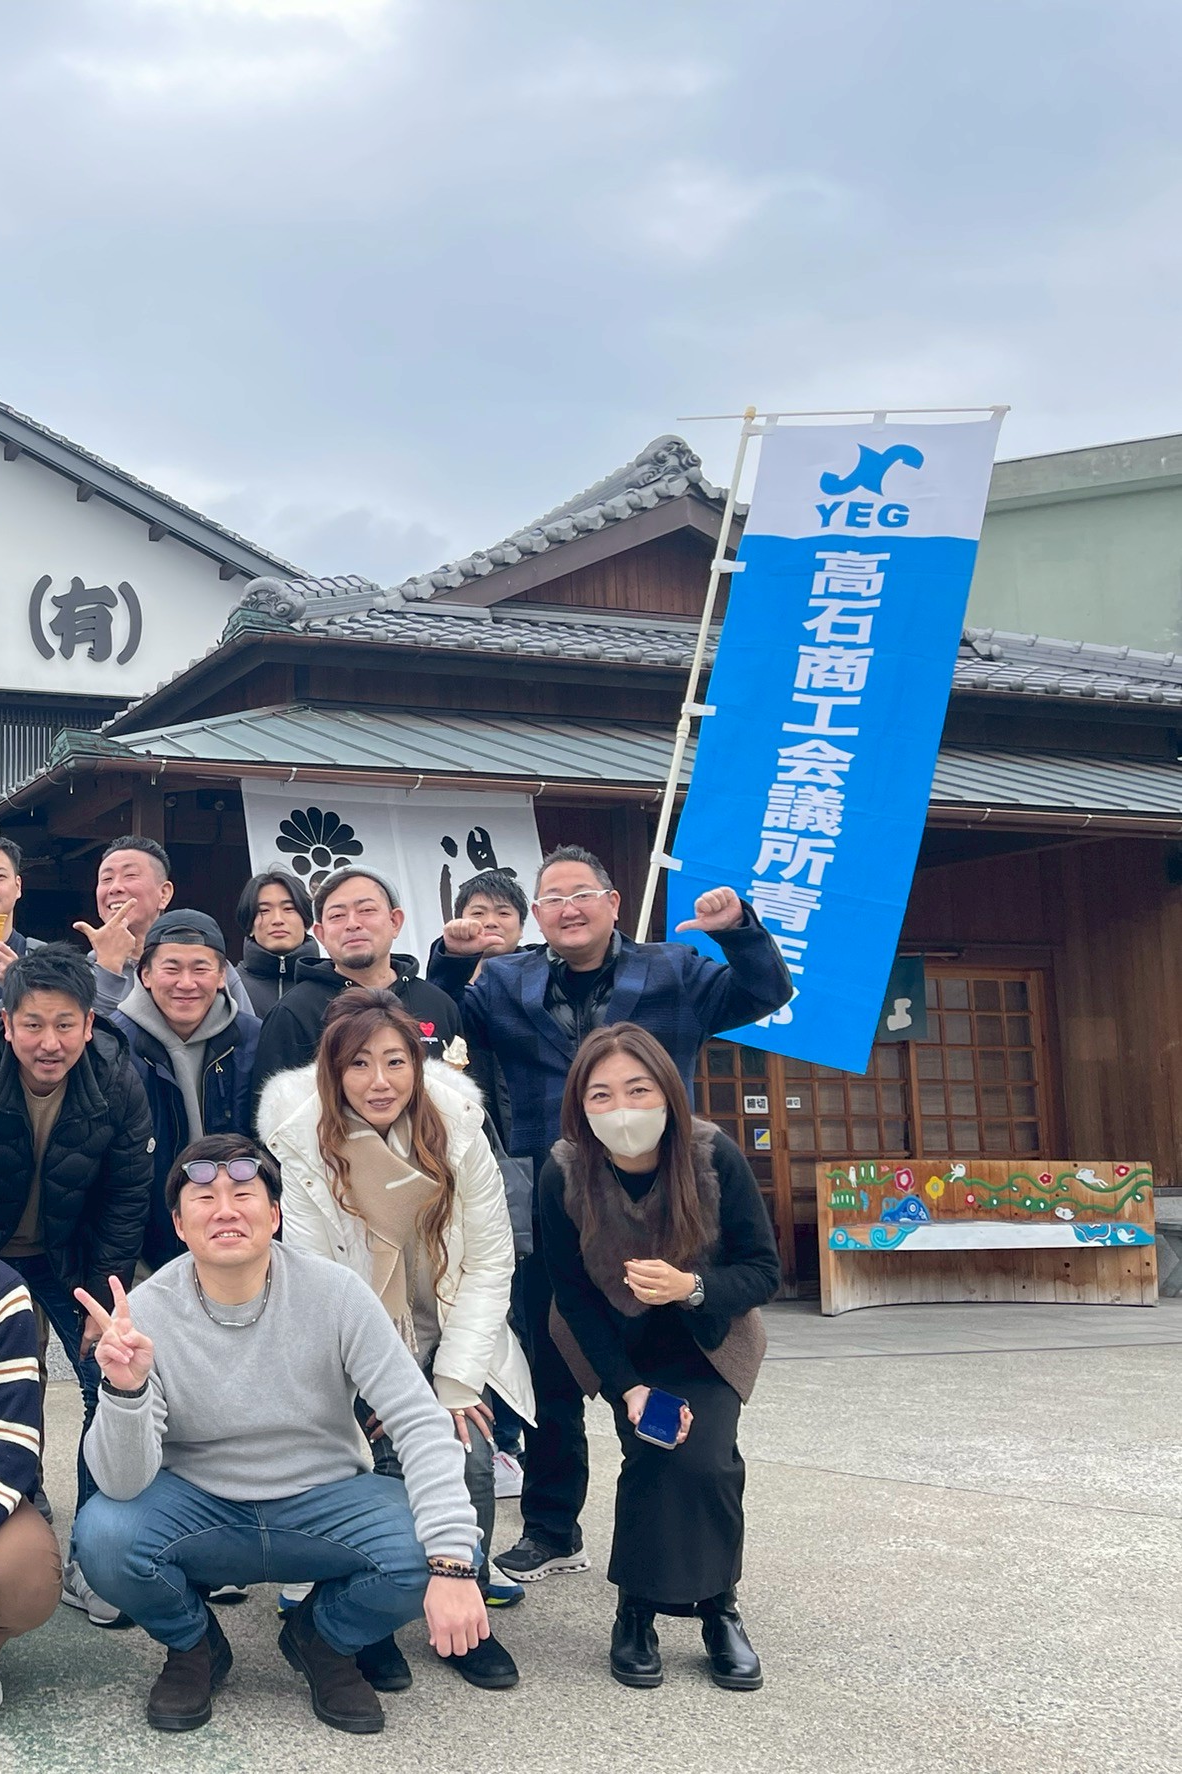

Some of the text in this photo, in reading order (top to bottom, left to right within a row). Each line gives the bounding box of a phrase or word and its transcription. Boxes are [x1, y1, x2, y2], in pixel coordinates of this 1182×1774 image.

[815, 501, 911, 529] YEG
[745, 550, 891, 1029] 高石商工会議所青
